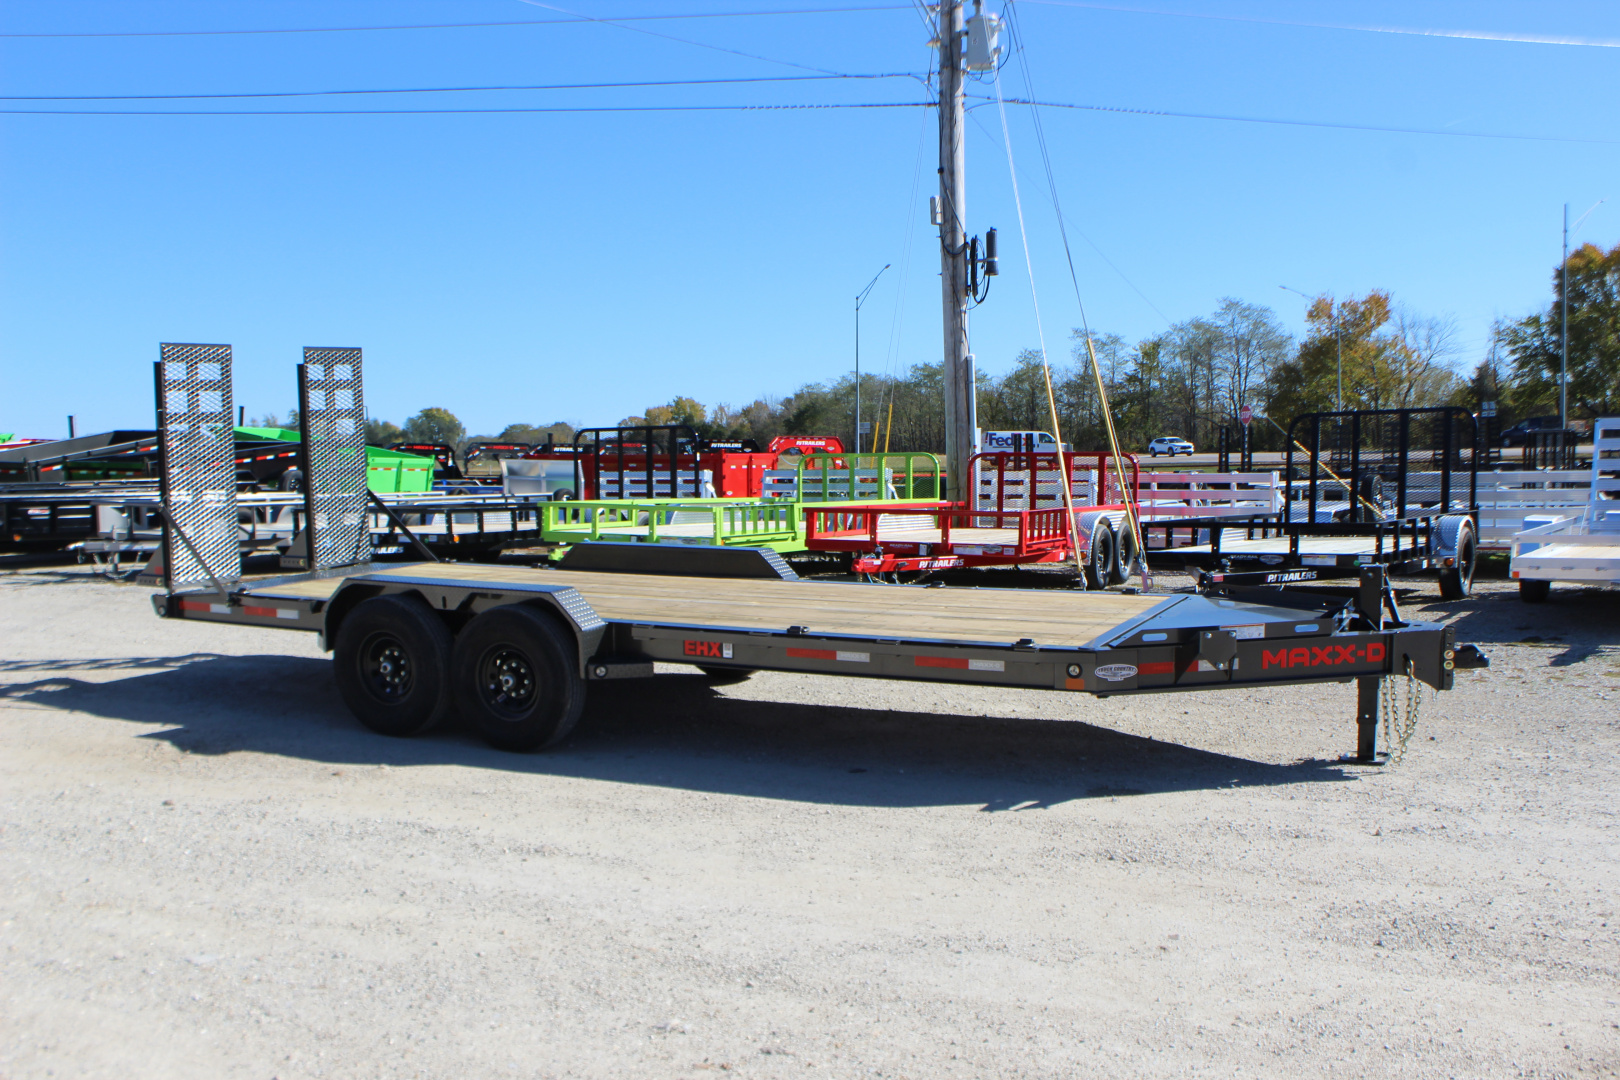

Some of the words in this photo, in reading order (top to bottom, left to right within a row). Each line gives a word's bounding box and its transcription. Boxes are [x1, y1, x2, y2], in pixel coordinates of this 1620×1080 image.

[1241, 411, 1251, 419] STOP
[989, 432, 1029, 447] Fed
[369, 546, 405, 555] RAILERS
[918, 560, 929, 569] PJ
[928, 558, 965, 568] TRAILERS
[1267, 573, 1278, 583] PJ
[1278, 570, 1318, 582] TRAILERS
[684, 639, 722, 657] EHX
[1262, 642, 1386, 670] MAXX-D
